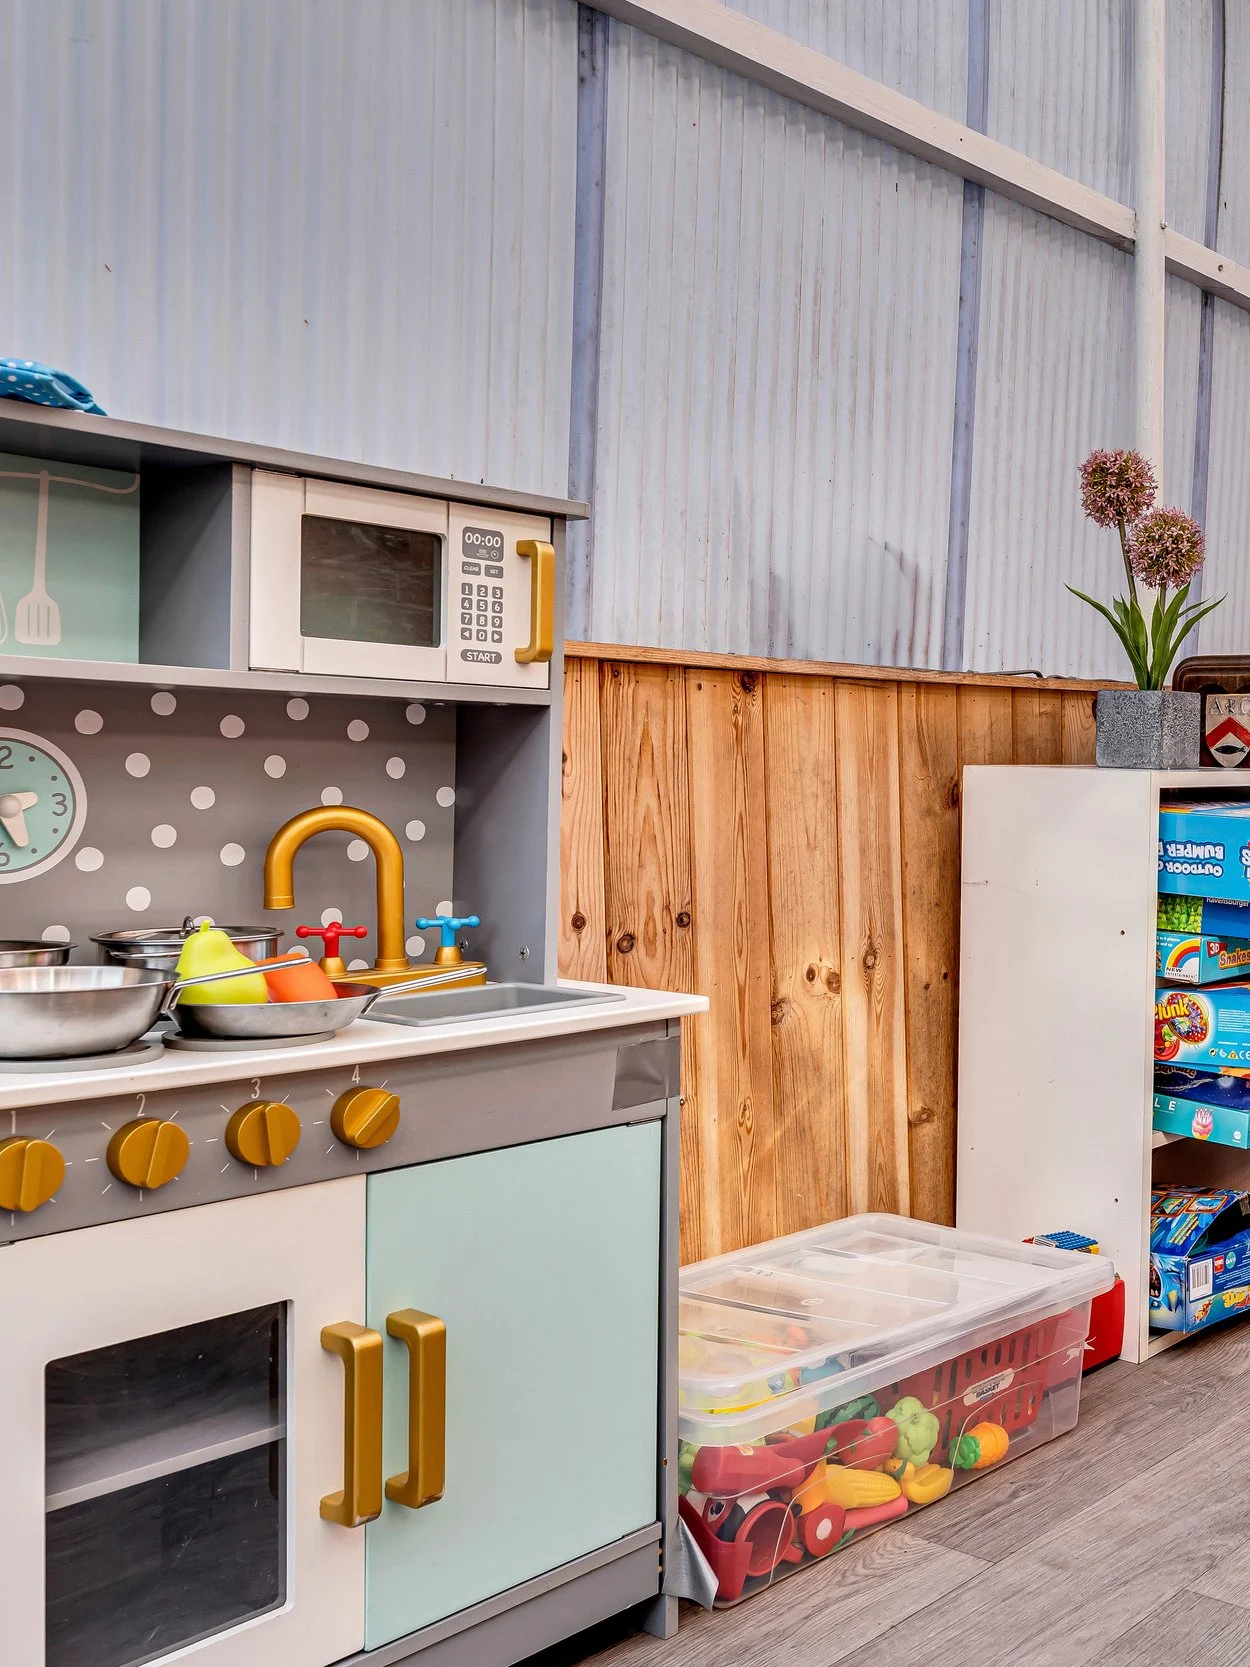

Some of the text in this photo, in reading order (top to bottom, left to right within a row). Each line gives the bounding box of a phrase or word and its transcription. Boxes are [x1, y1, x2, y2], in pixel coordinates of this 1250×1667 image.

[465, 532, 501, 547] 00:00
[463, 565, 479, 573] CLEAR
[465, 585, 501, 598] 1 2 3
[464, 600, 500, 611] 4 5 6
[464, 615, 500, 627] 7 8 9
[466, 652, 496, 662] START
[0, 745, 14, 770] 2
[51, 792, 68, 817] 3
[1166, 843, 1224, 859] BUMPER
[1165, 862, 1223, 877] OUTDOOR
[351, 1065, 361, 1084] 4
[251, 1078, 261, 1099] 3
[136, 1094, 146, 1117] 2
[11, 1110, 17, 1134] 1
